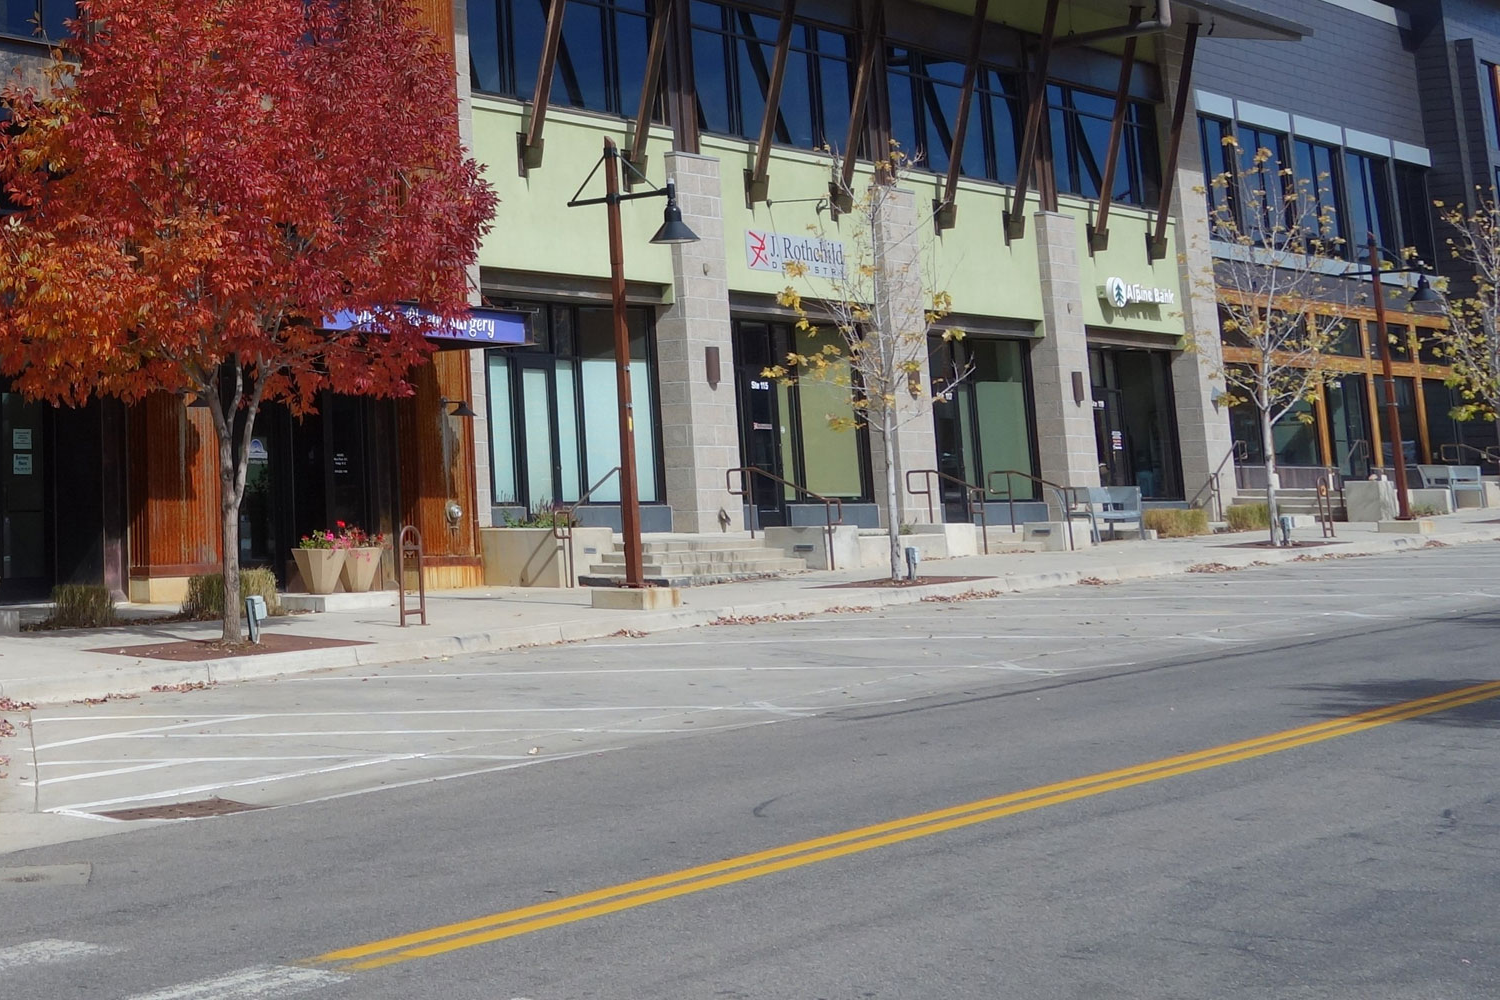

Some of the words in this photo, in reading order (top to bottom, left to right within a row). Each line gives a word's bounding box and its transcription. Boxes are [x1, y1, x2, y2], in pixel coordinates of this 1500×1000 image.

[770, 236, 779, 258] J.
[783, 237, 844, 265] Rothchild
[1126, 283, 1153, 303] Alpine
[1153, 288, 1174, 304] Bank
[751, 381, 760, 390] Ste
